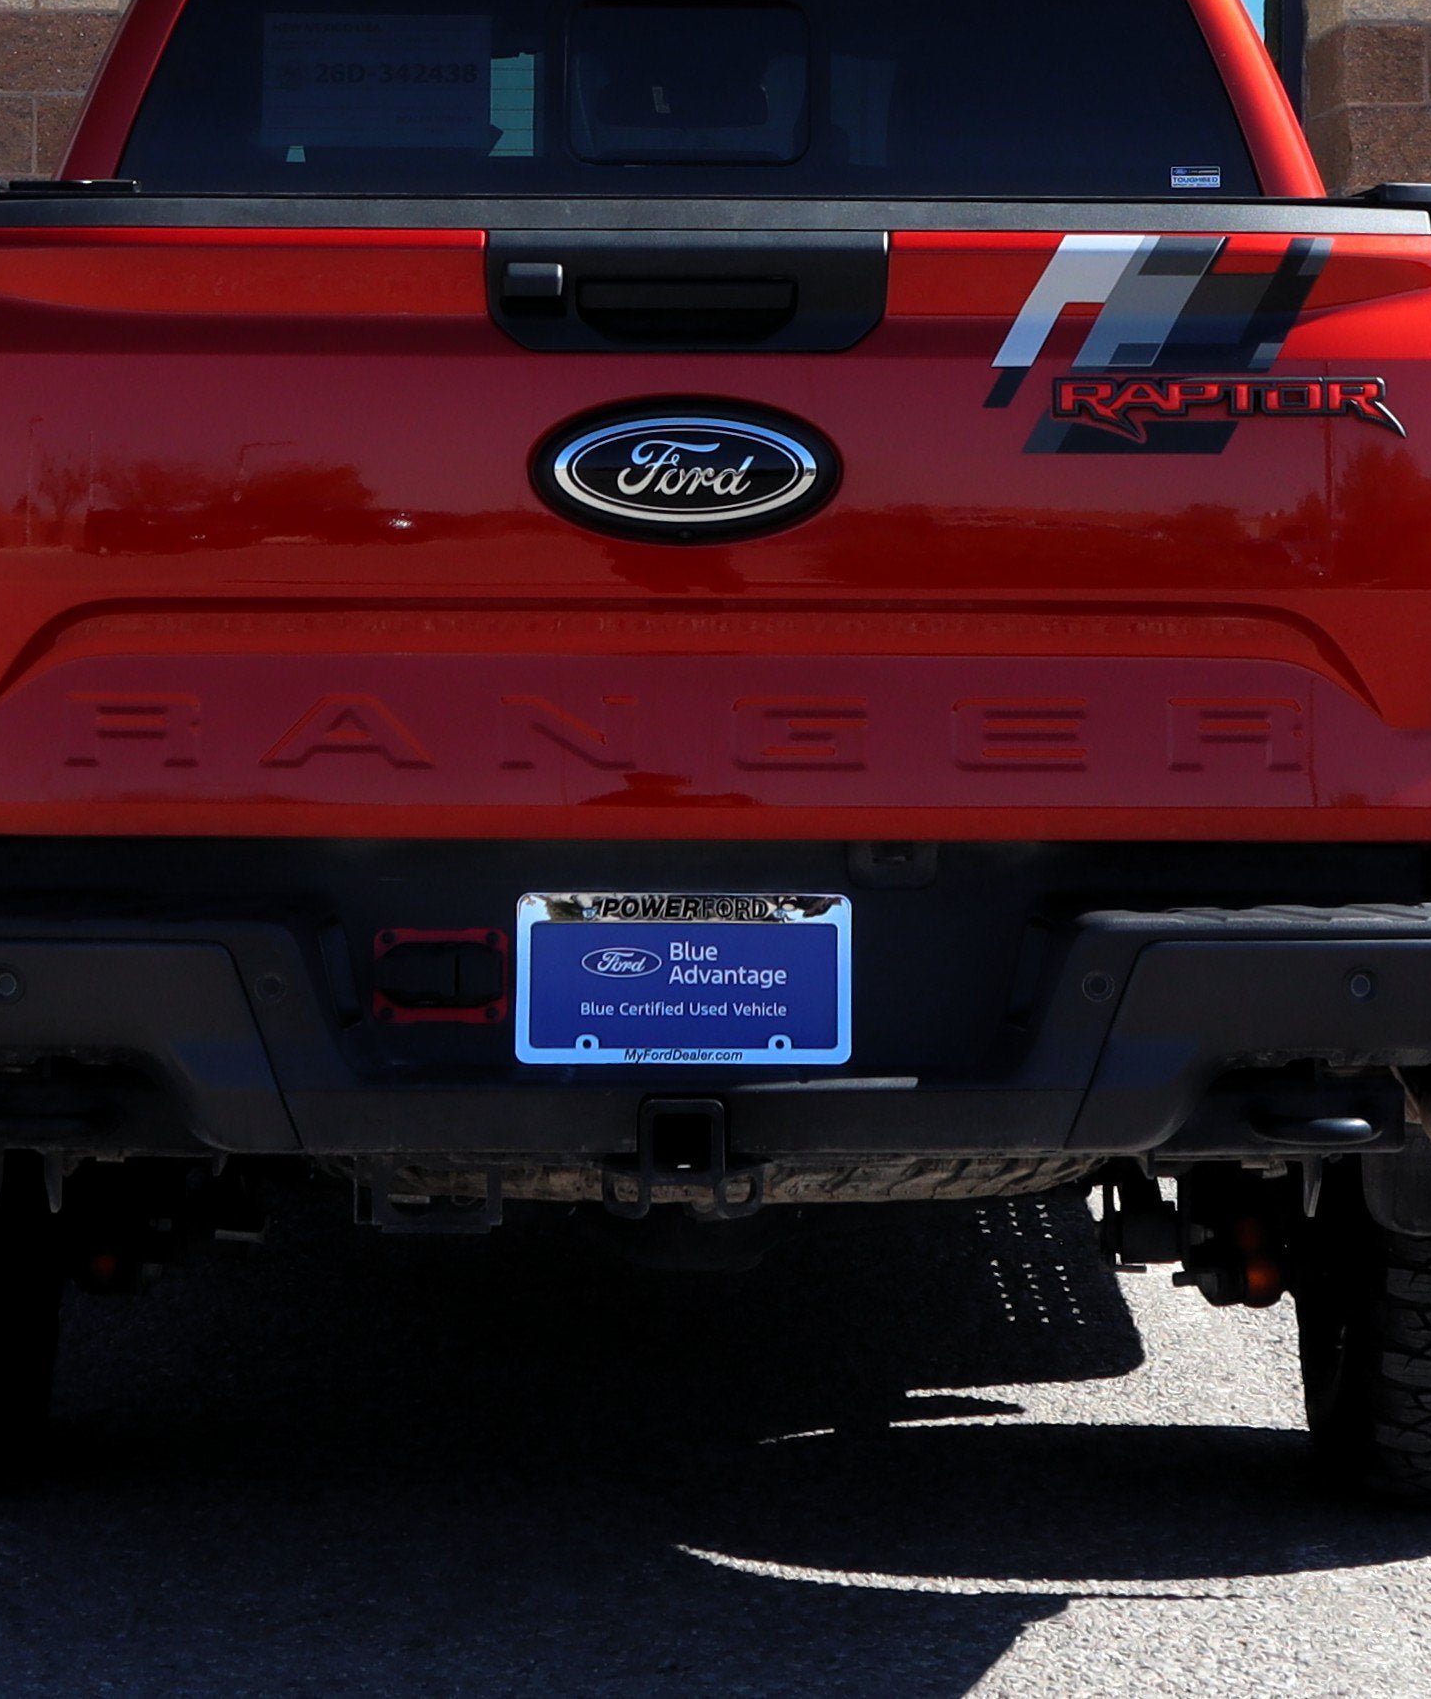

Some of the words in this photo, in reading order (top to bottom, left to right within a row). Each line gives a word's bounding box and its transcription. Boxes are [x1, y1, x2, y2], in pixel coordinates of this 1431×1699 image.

[1052, 376, 1406, 443] RAPTOR
[617, 439, 755, 496] Ford
[63, 688, 1304, 773] RANGER
[601, 899, 770, 920] POWERFORD
[596, 951, 646, 973] Ford
[669, 941, 718, 962] Blue
[668, 965, 788, 989] Advantage
[580, 1001, 615, 1016] Blue
[619, 1001, 684, 1016] Certified
[689, 1002, 728, 1017] Used
[732, 1002, 788, 1017] Vehicle
[623, 1048, 743, 1064] MyFordDealer.com
